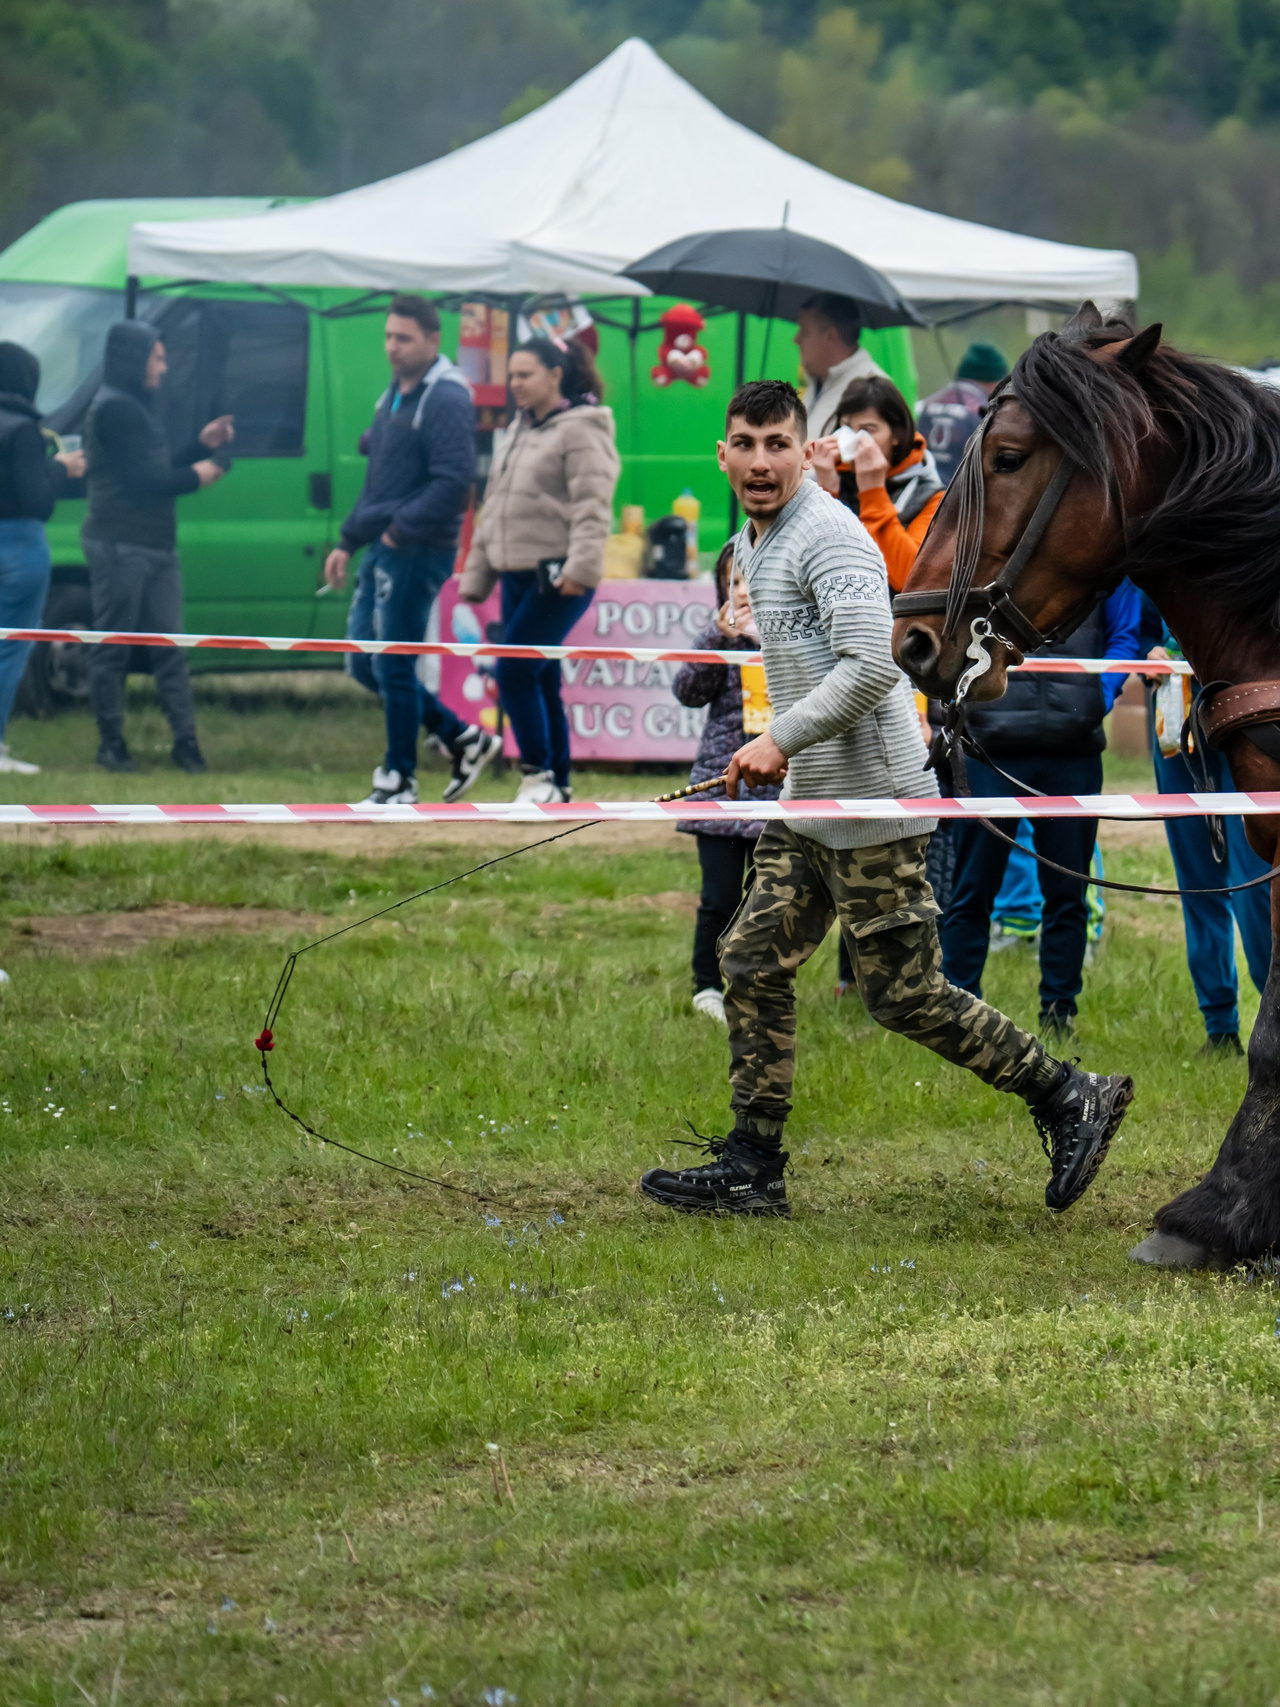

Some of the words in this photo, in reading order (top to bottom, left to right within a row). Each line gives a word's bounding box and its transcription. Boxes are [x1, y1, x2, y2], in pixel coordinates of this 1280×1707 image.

[595, 601, 719, 636] POPC
[565, 703, 632, 738] UC
[643, 703, 704, 738] GR
